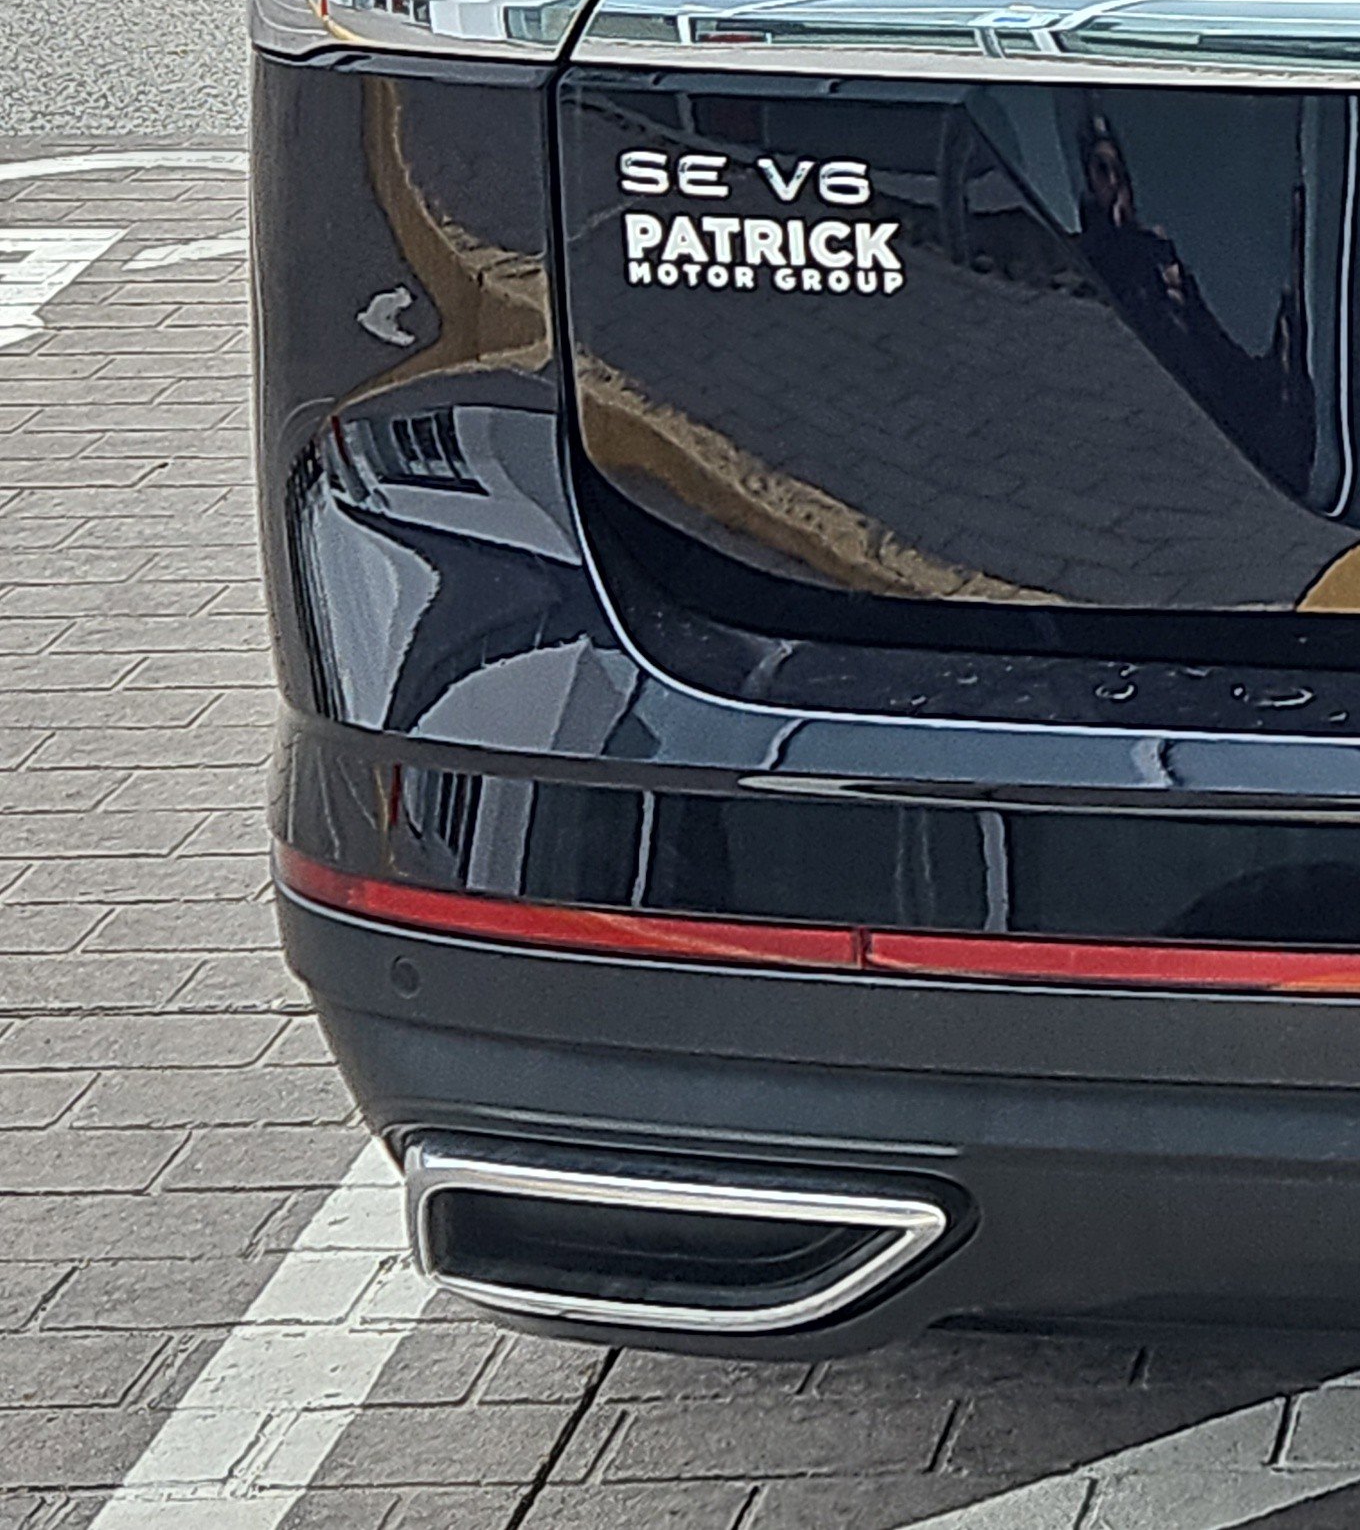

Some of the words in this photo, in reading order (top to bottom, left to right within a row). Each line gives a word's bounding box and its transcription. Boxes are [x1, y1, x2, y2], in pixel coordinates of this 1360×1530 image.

[620, 151, 729, 198] SE
[757, 160, 871, 205] V6
[624, 214, 901, 268] PATRICK
[628, 262, 755, 289] MOTOR
[774, 268, 904, 294] GROUP
